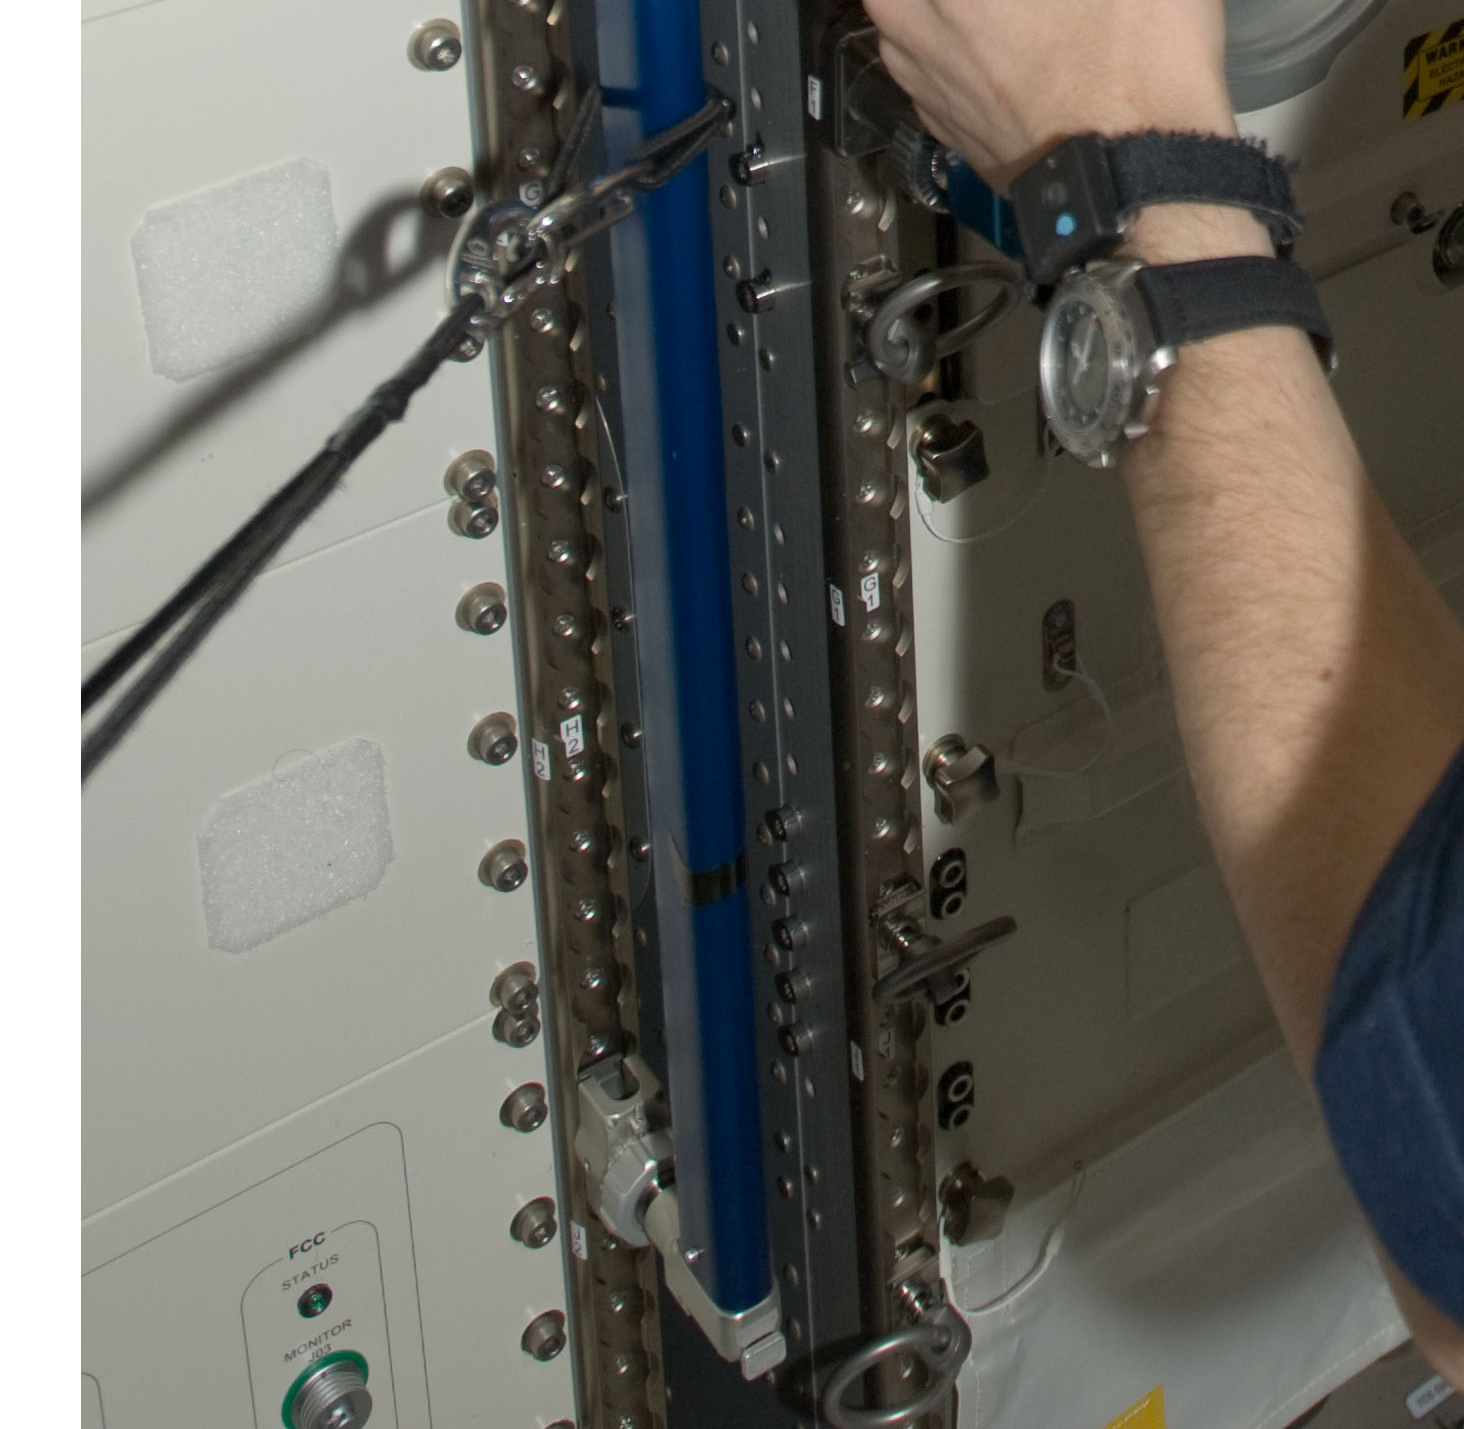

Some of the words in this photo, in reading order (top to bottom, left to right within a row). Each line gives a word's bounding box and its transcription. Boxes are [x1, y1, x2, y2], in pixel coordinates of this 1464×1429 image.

[289, 1231, 326, 1260] FCC
[281, 1253, 340, 1291] STATUS
[284, 1319, 352, 1363] MONITOR
[308, 1343, 332, 1362] J03
